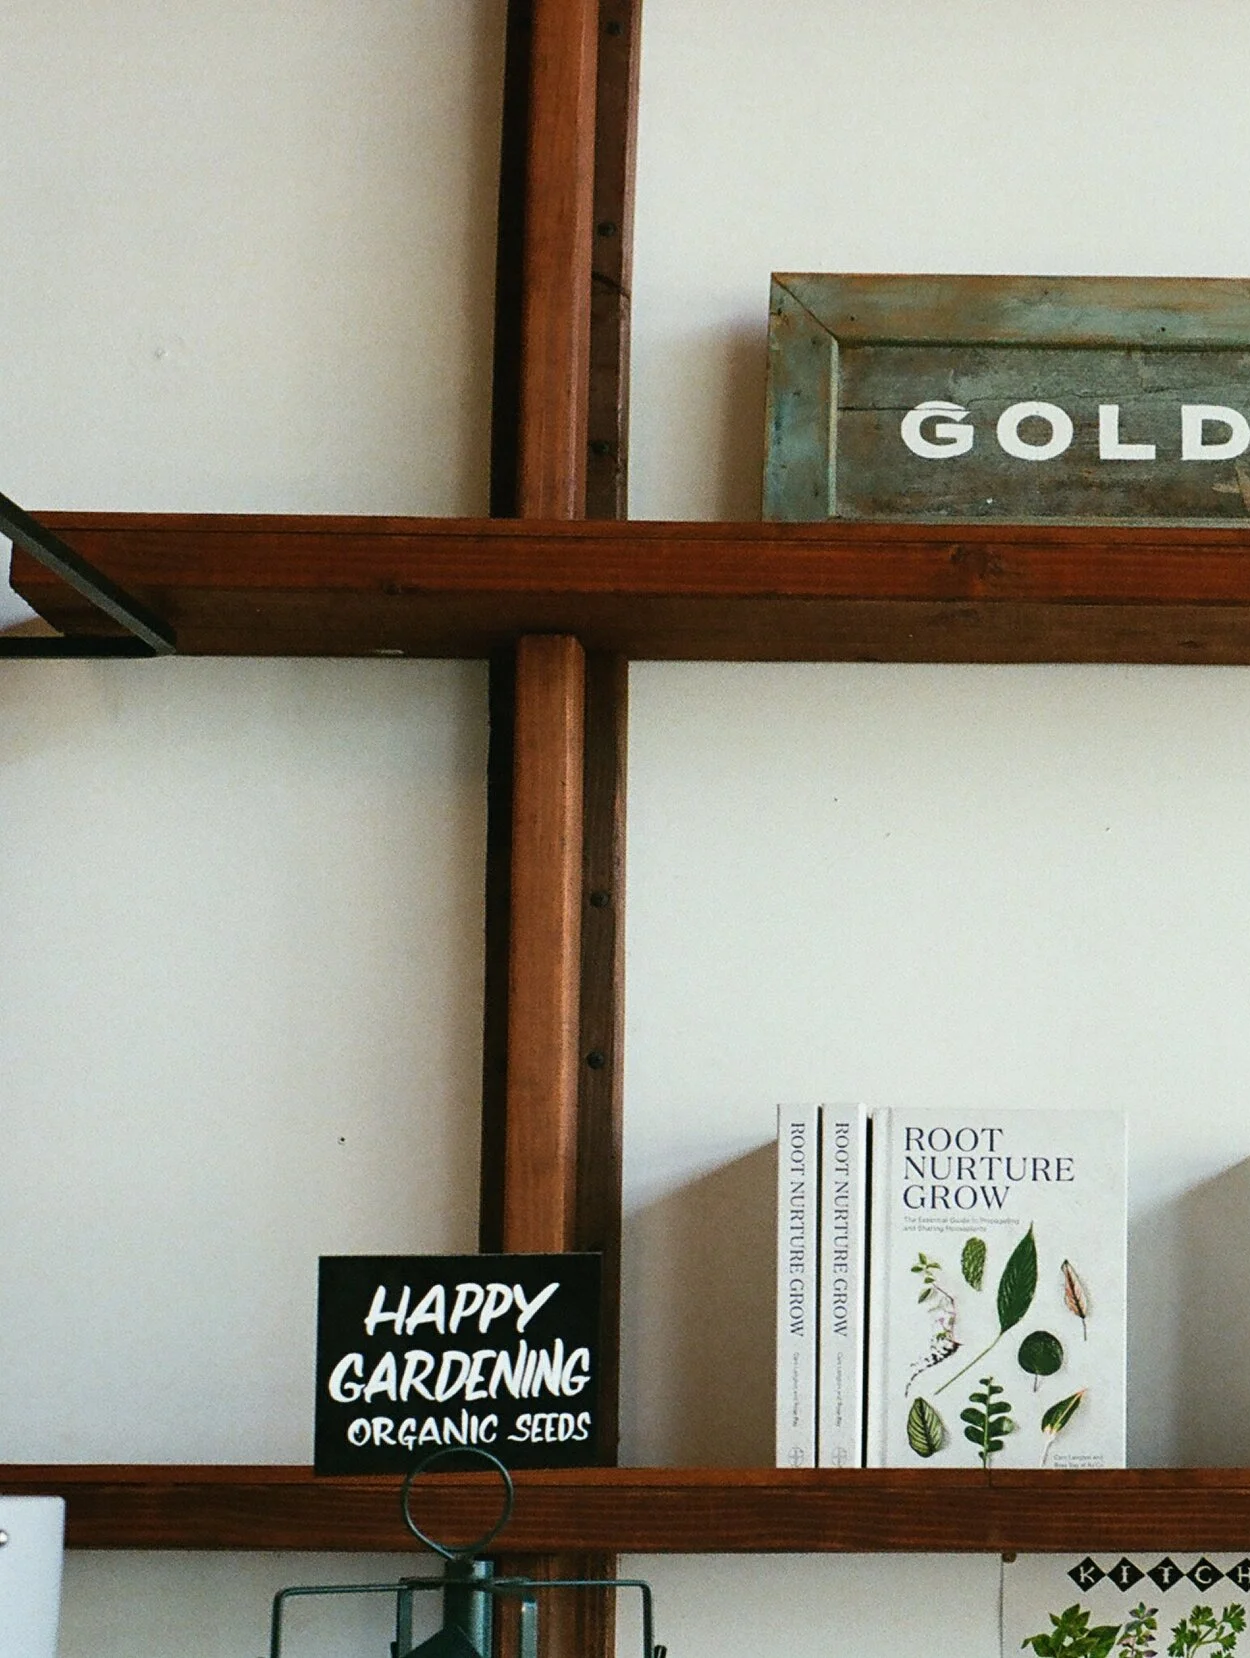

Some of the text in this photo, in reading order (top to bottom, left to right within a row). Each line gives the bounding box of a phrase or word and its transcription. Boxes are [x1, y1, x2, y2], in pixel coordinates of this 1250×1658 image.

[904, 1126, 1004, 1153] ROOT
[903, 1155, 1076, 1182] NURTURE
[902, 1184, 1011, 1211] GROW
[788, 1122, 805, 1337] ROOT NURTURE GROW
[832, 1122, 850, 1337] ROOT NURTURE GROW
[364, 1282, 560, 1336] HAPPY
[328, 1337, 591, 1403] GARDENING
[347, 1408, 592, 1450] ORGANIC SEEDS
